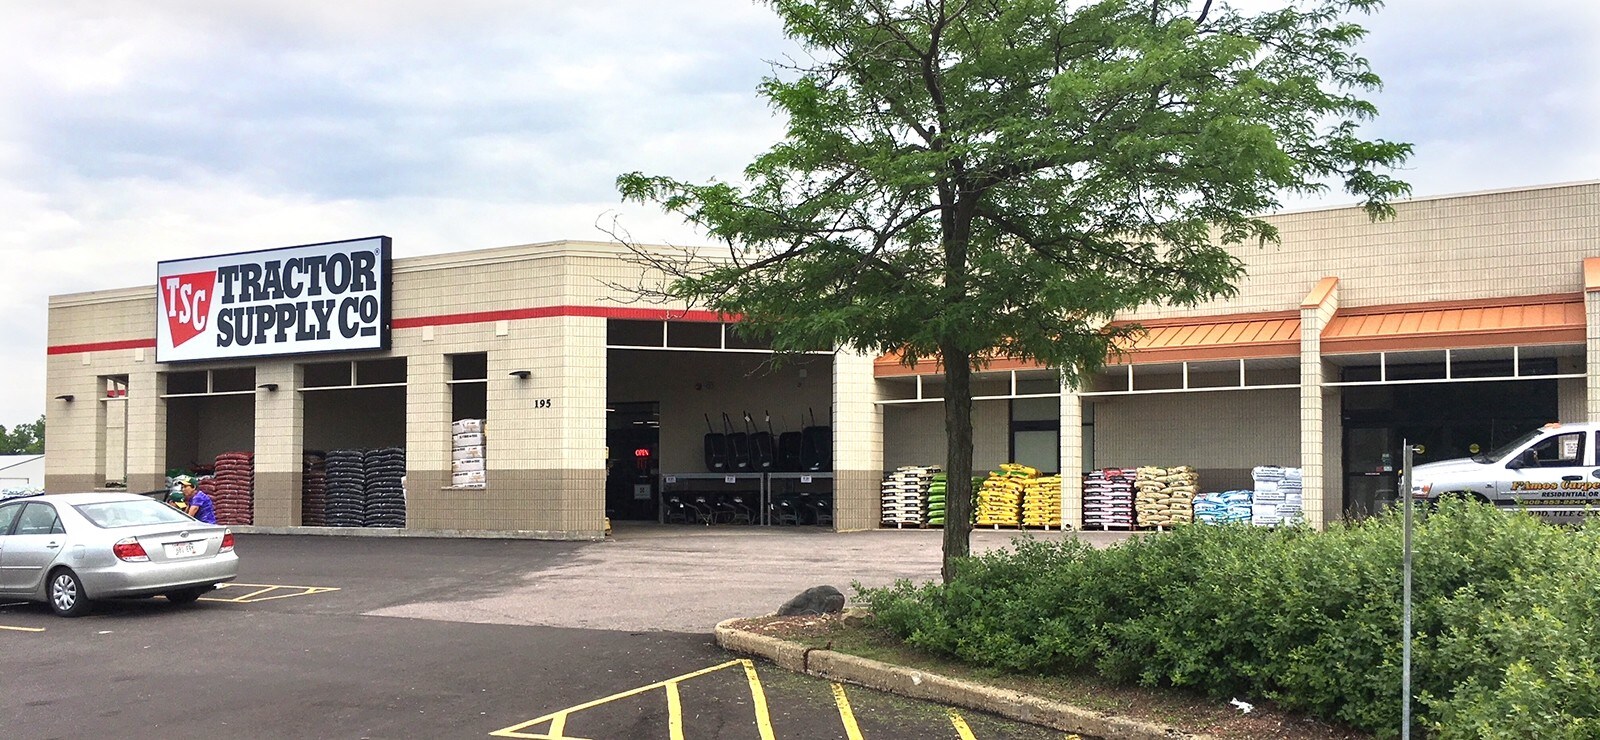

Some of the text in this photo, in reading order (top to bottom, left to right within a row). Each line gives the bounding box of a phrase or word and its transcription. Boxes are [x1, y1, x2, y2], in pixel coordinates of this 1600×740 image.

[217, 251, 376, 304] TRACTOR
[166, 277, 206, 331] TSC
[216, 299, 336, 348] SUPPLY
[535, 399, 551, 408] 195
